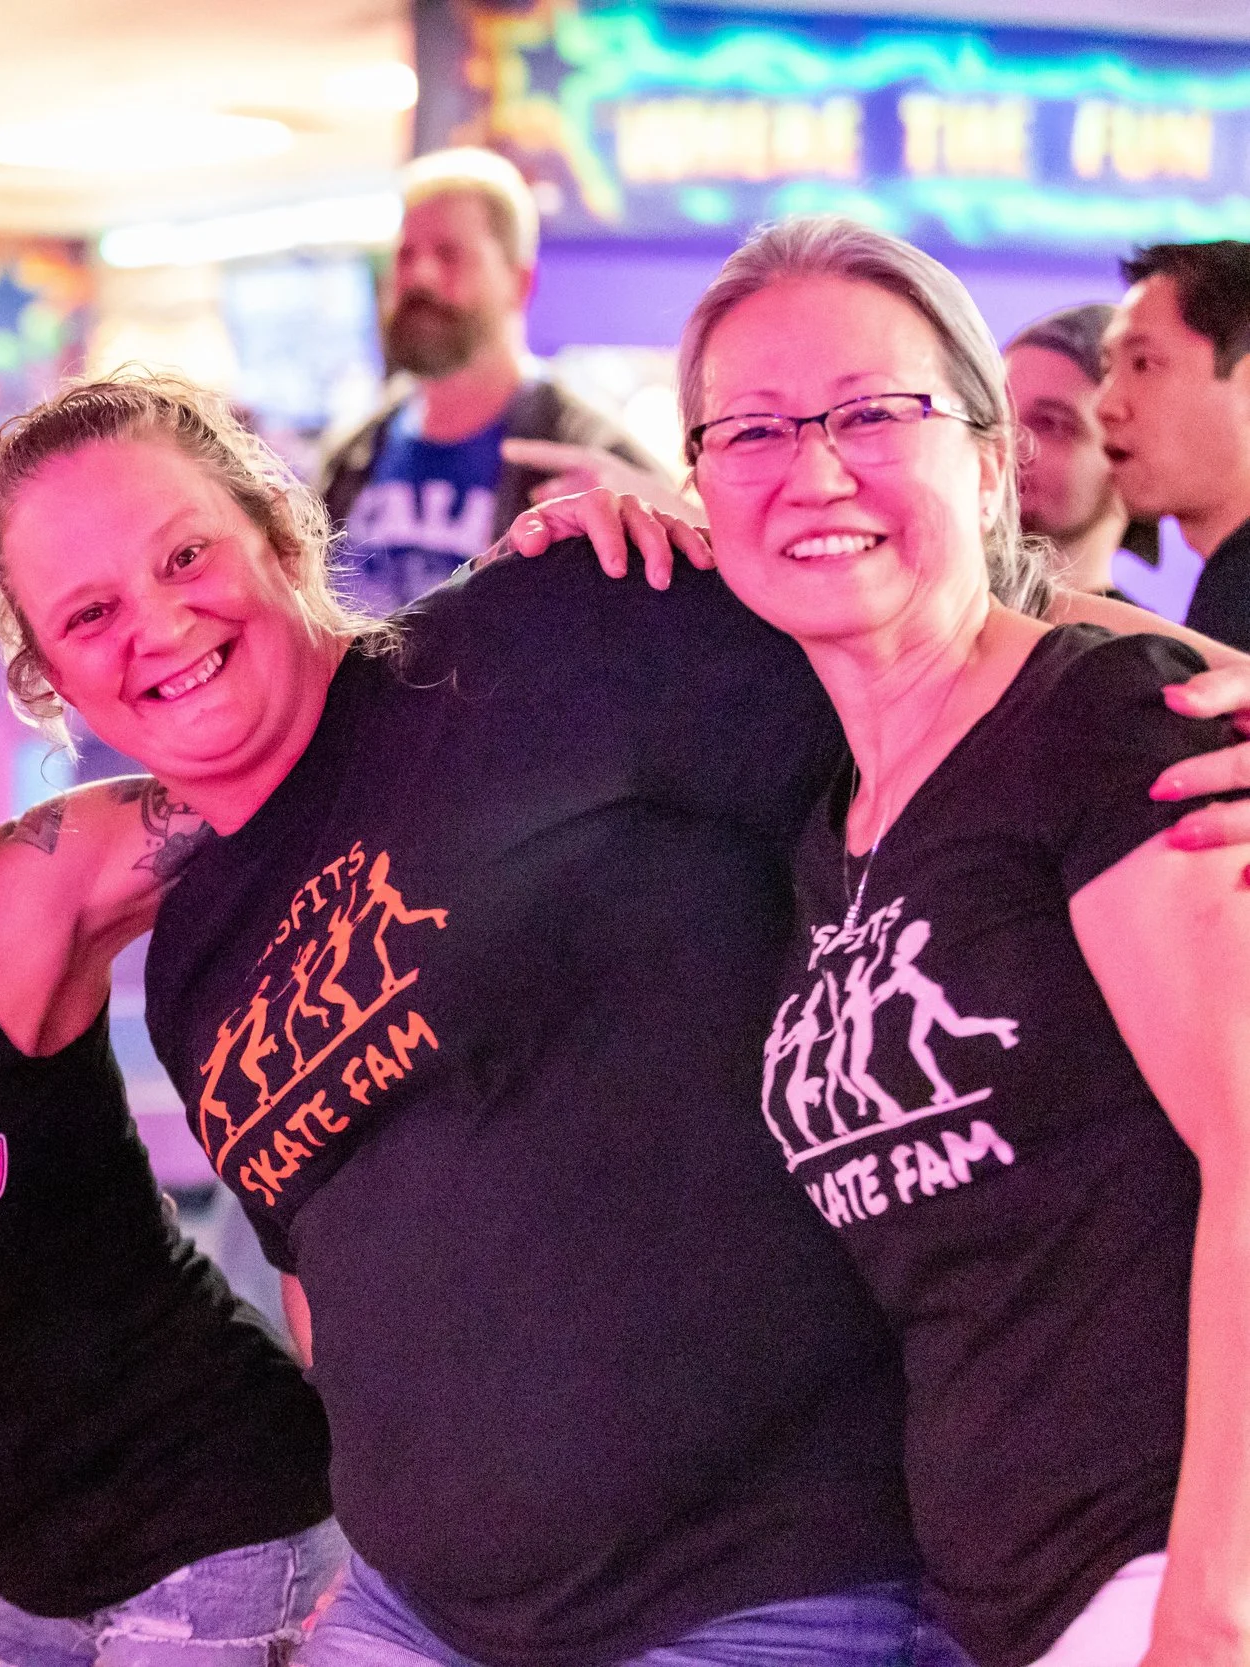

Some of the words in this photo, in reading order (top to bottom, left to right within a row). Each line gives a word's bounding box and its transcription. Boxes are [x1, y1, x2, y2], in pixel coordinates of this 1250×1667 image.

[239, 1089, 350, 1206] SKATE
[341, 1010, 439, 1106] FAM
[890, 1120, 1015, 1204] FAM
